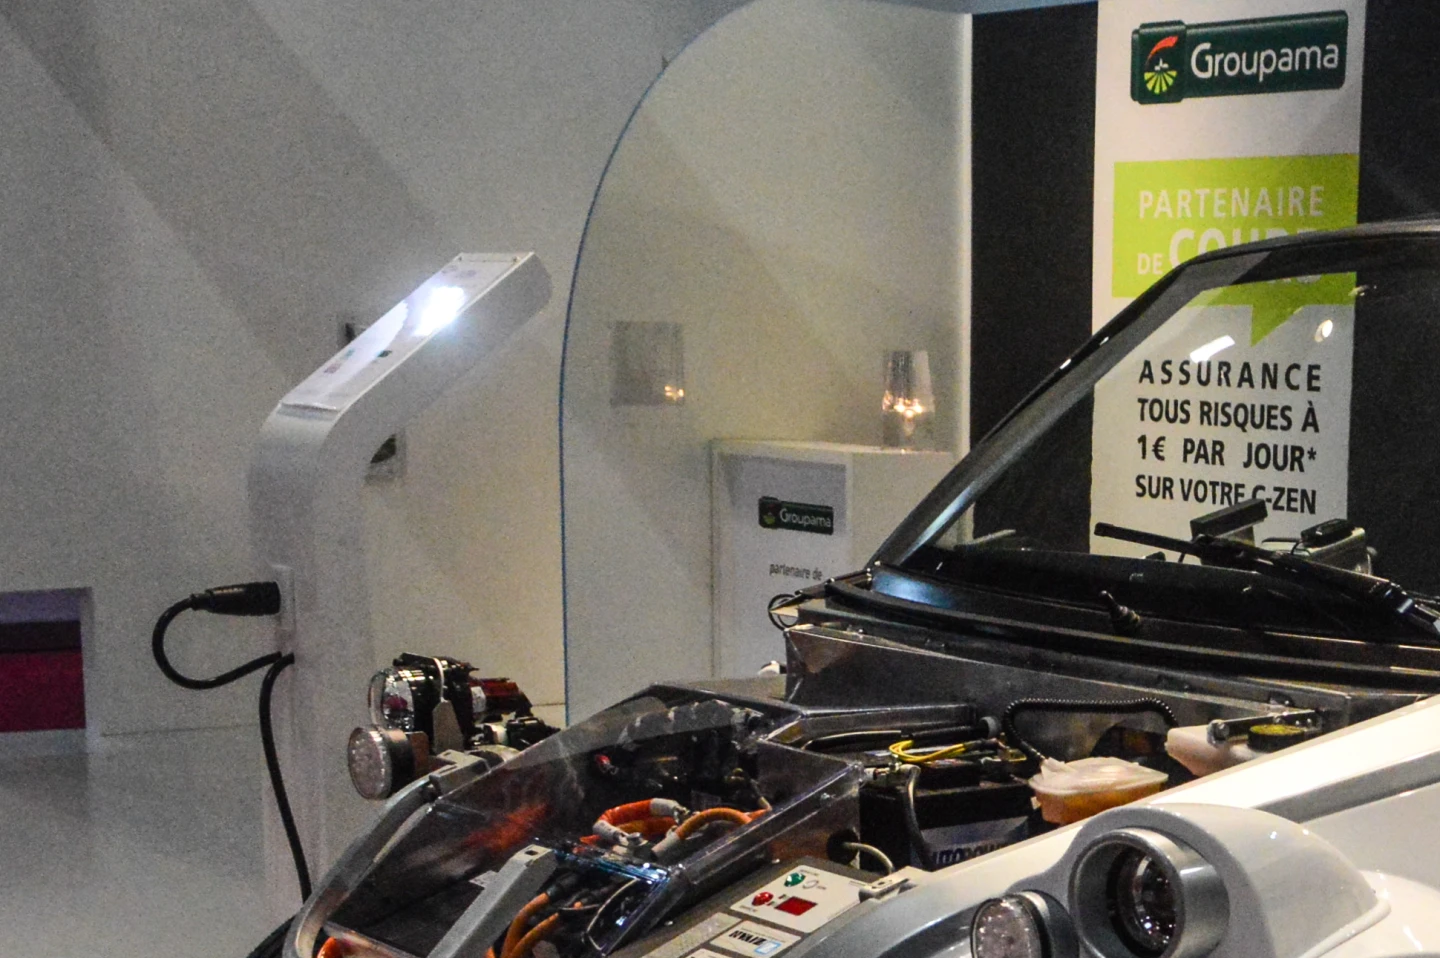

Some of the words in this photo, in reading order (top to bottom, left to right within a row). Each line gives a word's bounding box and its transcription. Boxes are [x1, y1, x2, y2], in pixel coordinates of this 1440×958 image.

[1190, 42, 1339, 82] Groupama
[1138, 186, 1325, 219] PARTENAIRE
[1137, 252, 1163, 276] DE
[1138, 359, 1321, 392] ASSURANCE
[1137, 398, 1190, 424] TOUS
[1199, 400, 1293, 433] RISQUES
[1301, 400, 1320, 433] À
[1137, 434, 1166, 462] 1€
[1183, 437, 1225, 466] PAR
[1135, 474, 1174, 500] SUR
[1180, 478, 1245, 506] VOTRE
[1251, 484, 1317, 515] C-ZEN
[779, 507, 831, 528] Groupama
[769, 562, 811, 579] partenaire
[813, 569, 823, 581] de
